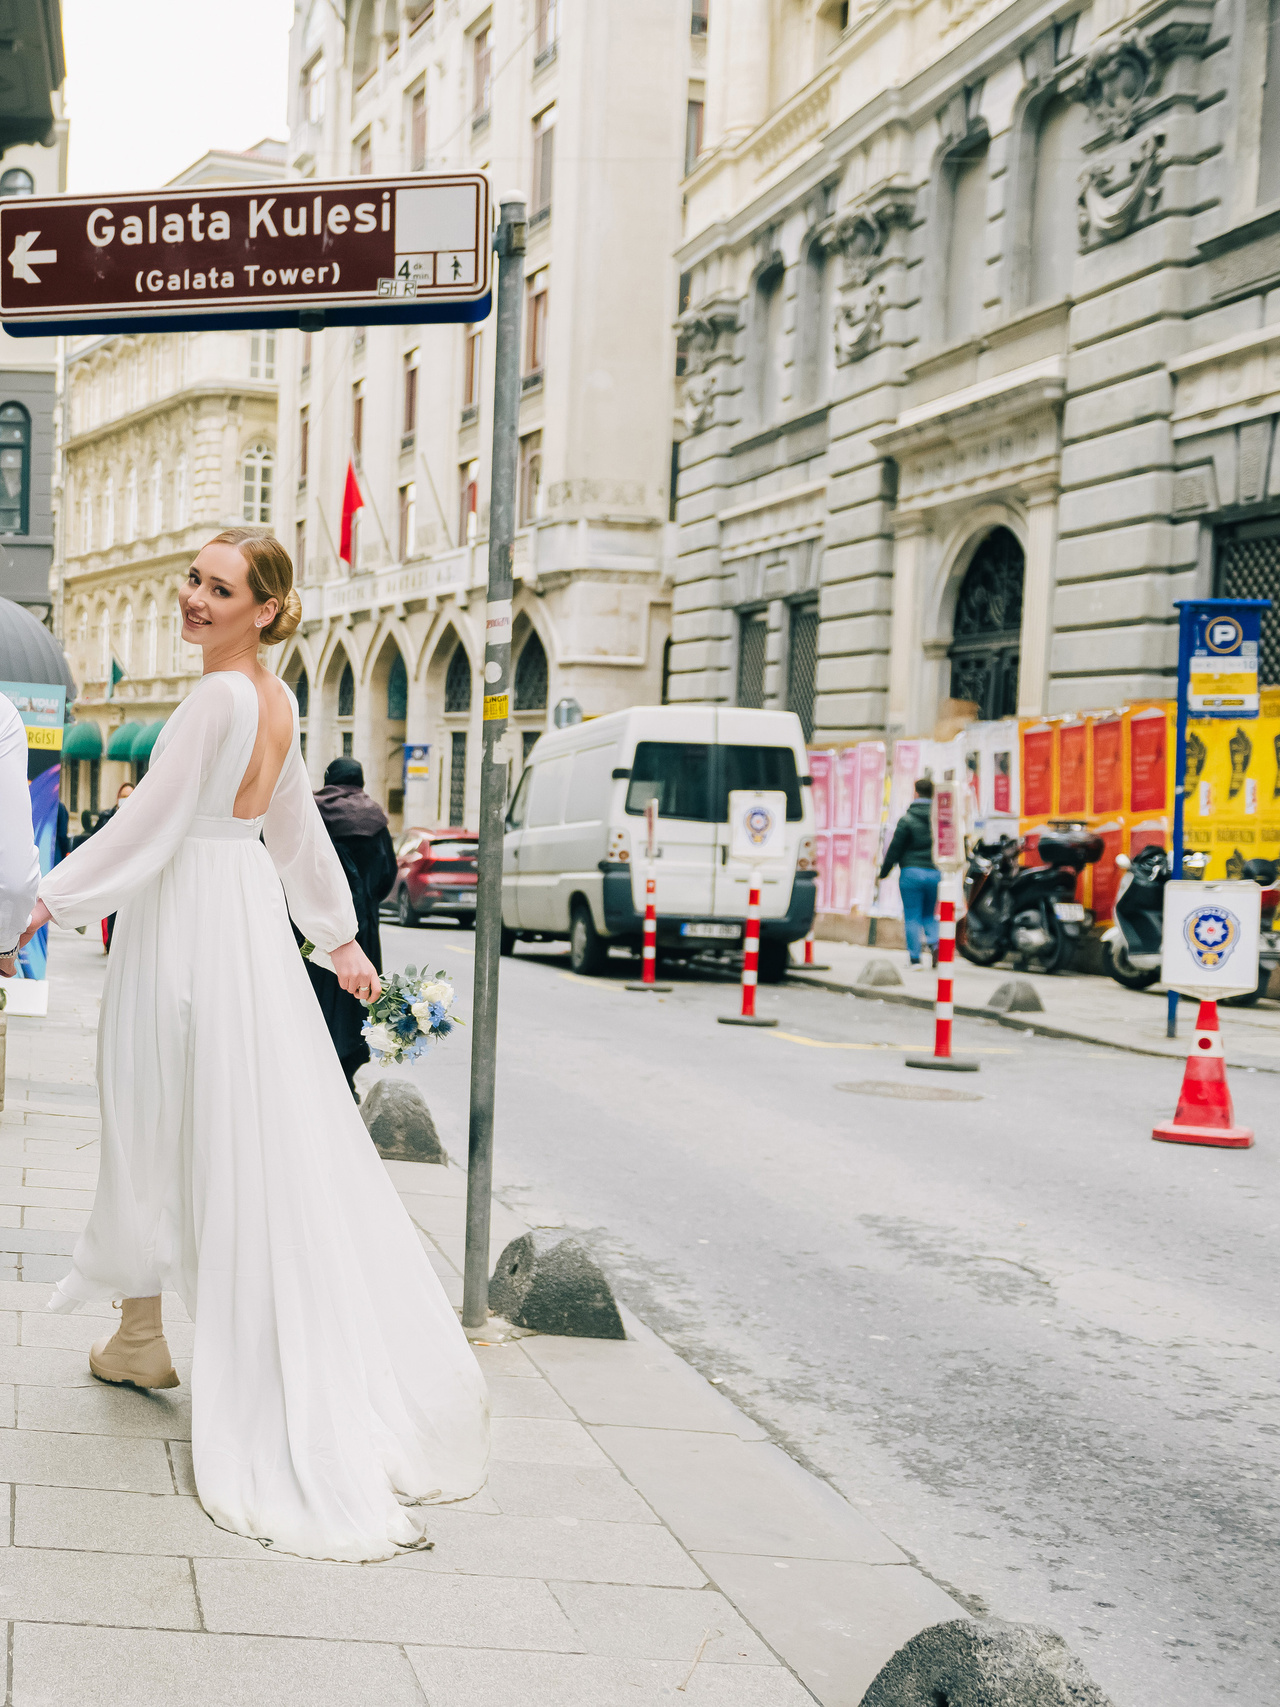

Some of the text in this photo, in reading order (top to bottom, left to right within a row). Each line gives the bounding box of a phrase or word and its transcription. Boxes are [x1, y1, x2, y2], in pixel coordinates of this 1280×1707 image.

[86, 190, 391, 247] Galata Kulesi
[134, 261, 341, 293] (Galata Tower)
[398, 259, 411, 280] 4
[1213, 624, 1236, 645] P
